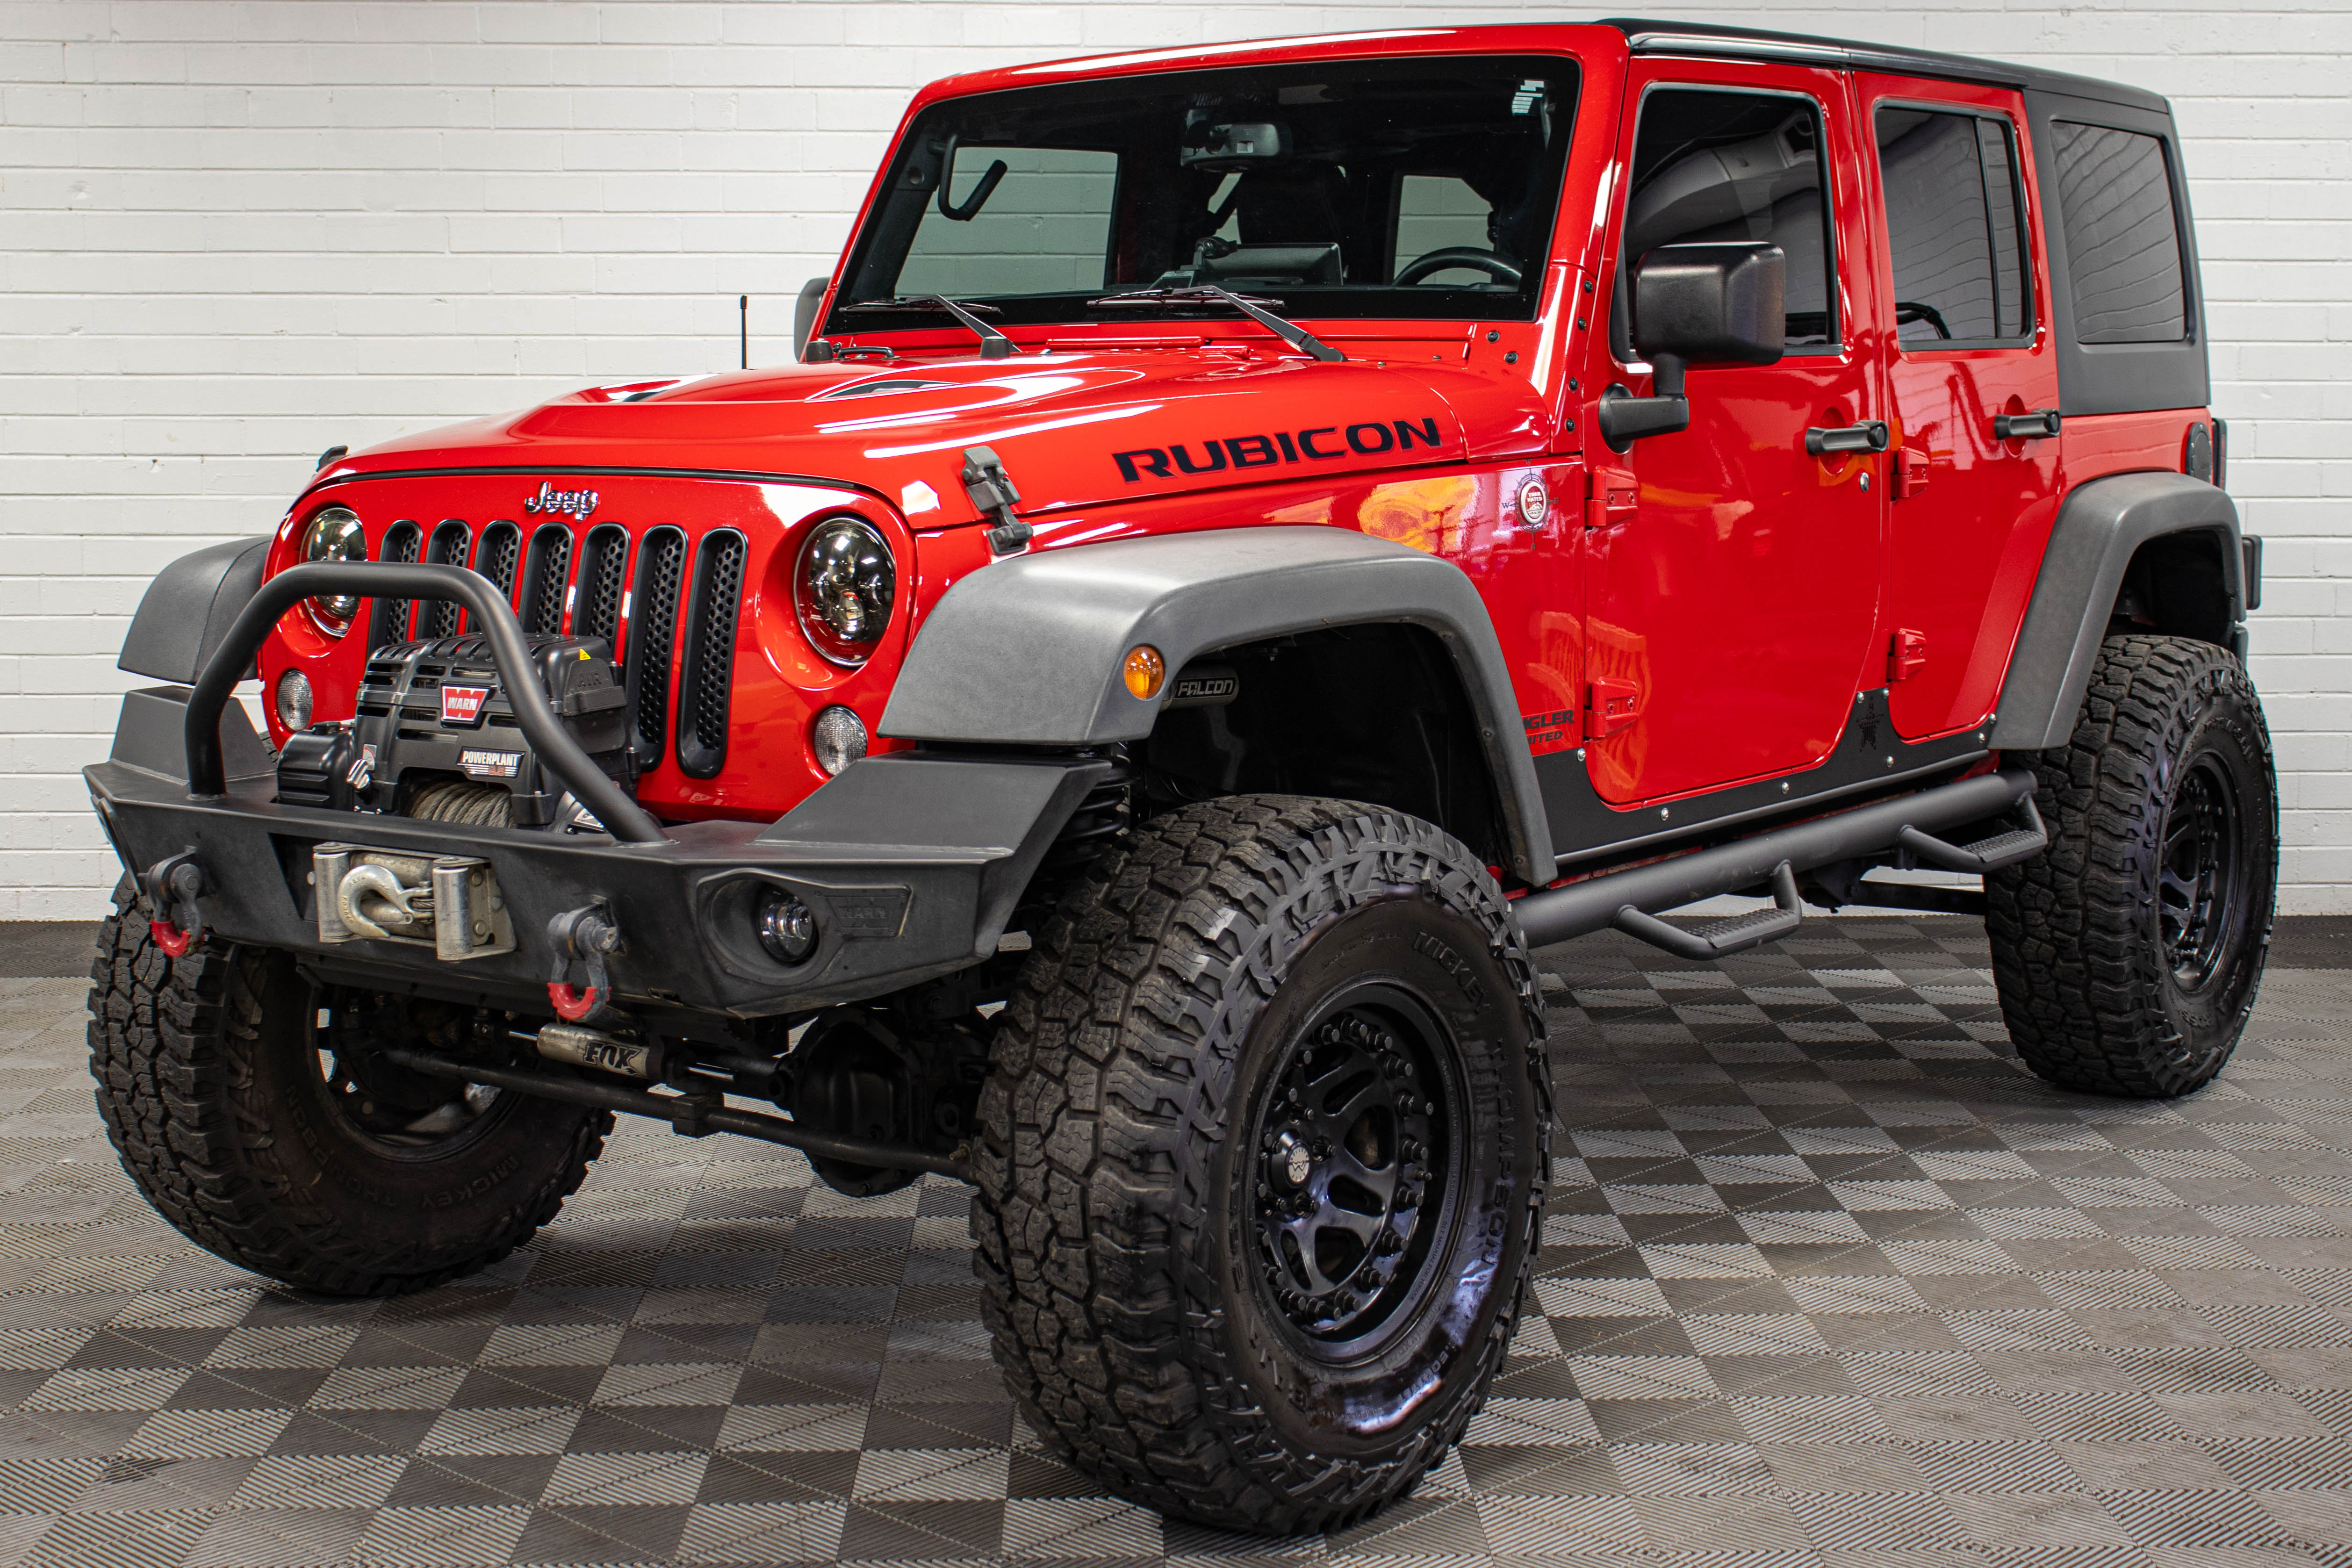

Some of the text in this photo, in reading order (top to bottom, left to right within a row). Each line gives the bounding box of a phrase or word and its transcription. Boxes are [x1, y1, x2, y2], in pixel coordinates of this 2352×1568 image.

[1112, 417, 1443, 483] RUBICON
[525, 481, 598, 521] Jeep
[1178, 680, 1233, 696] FALCON
[447, 697, 478, 711] WARN
[462, 751, 519, 767] POWERPLANT
[488, 765, 506, 777] 9.5
[1412, 929, 1495, 1014] MICKEY
[584, 1039, 643, 1070] FOX
